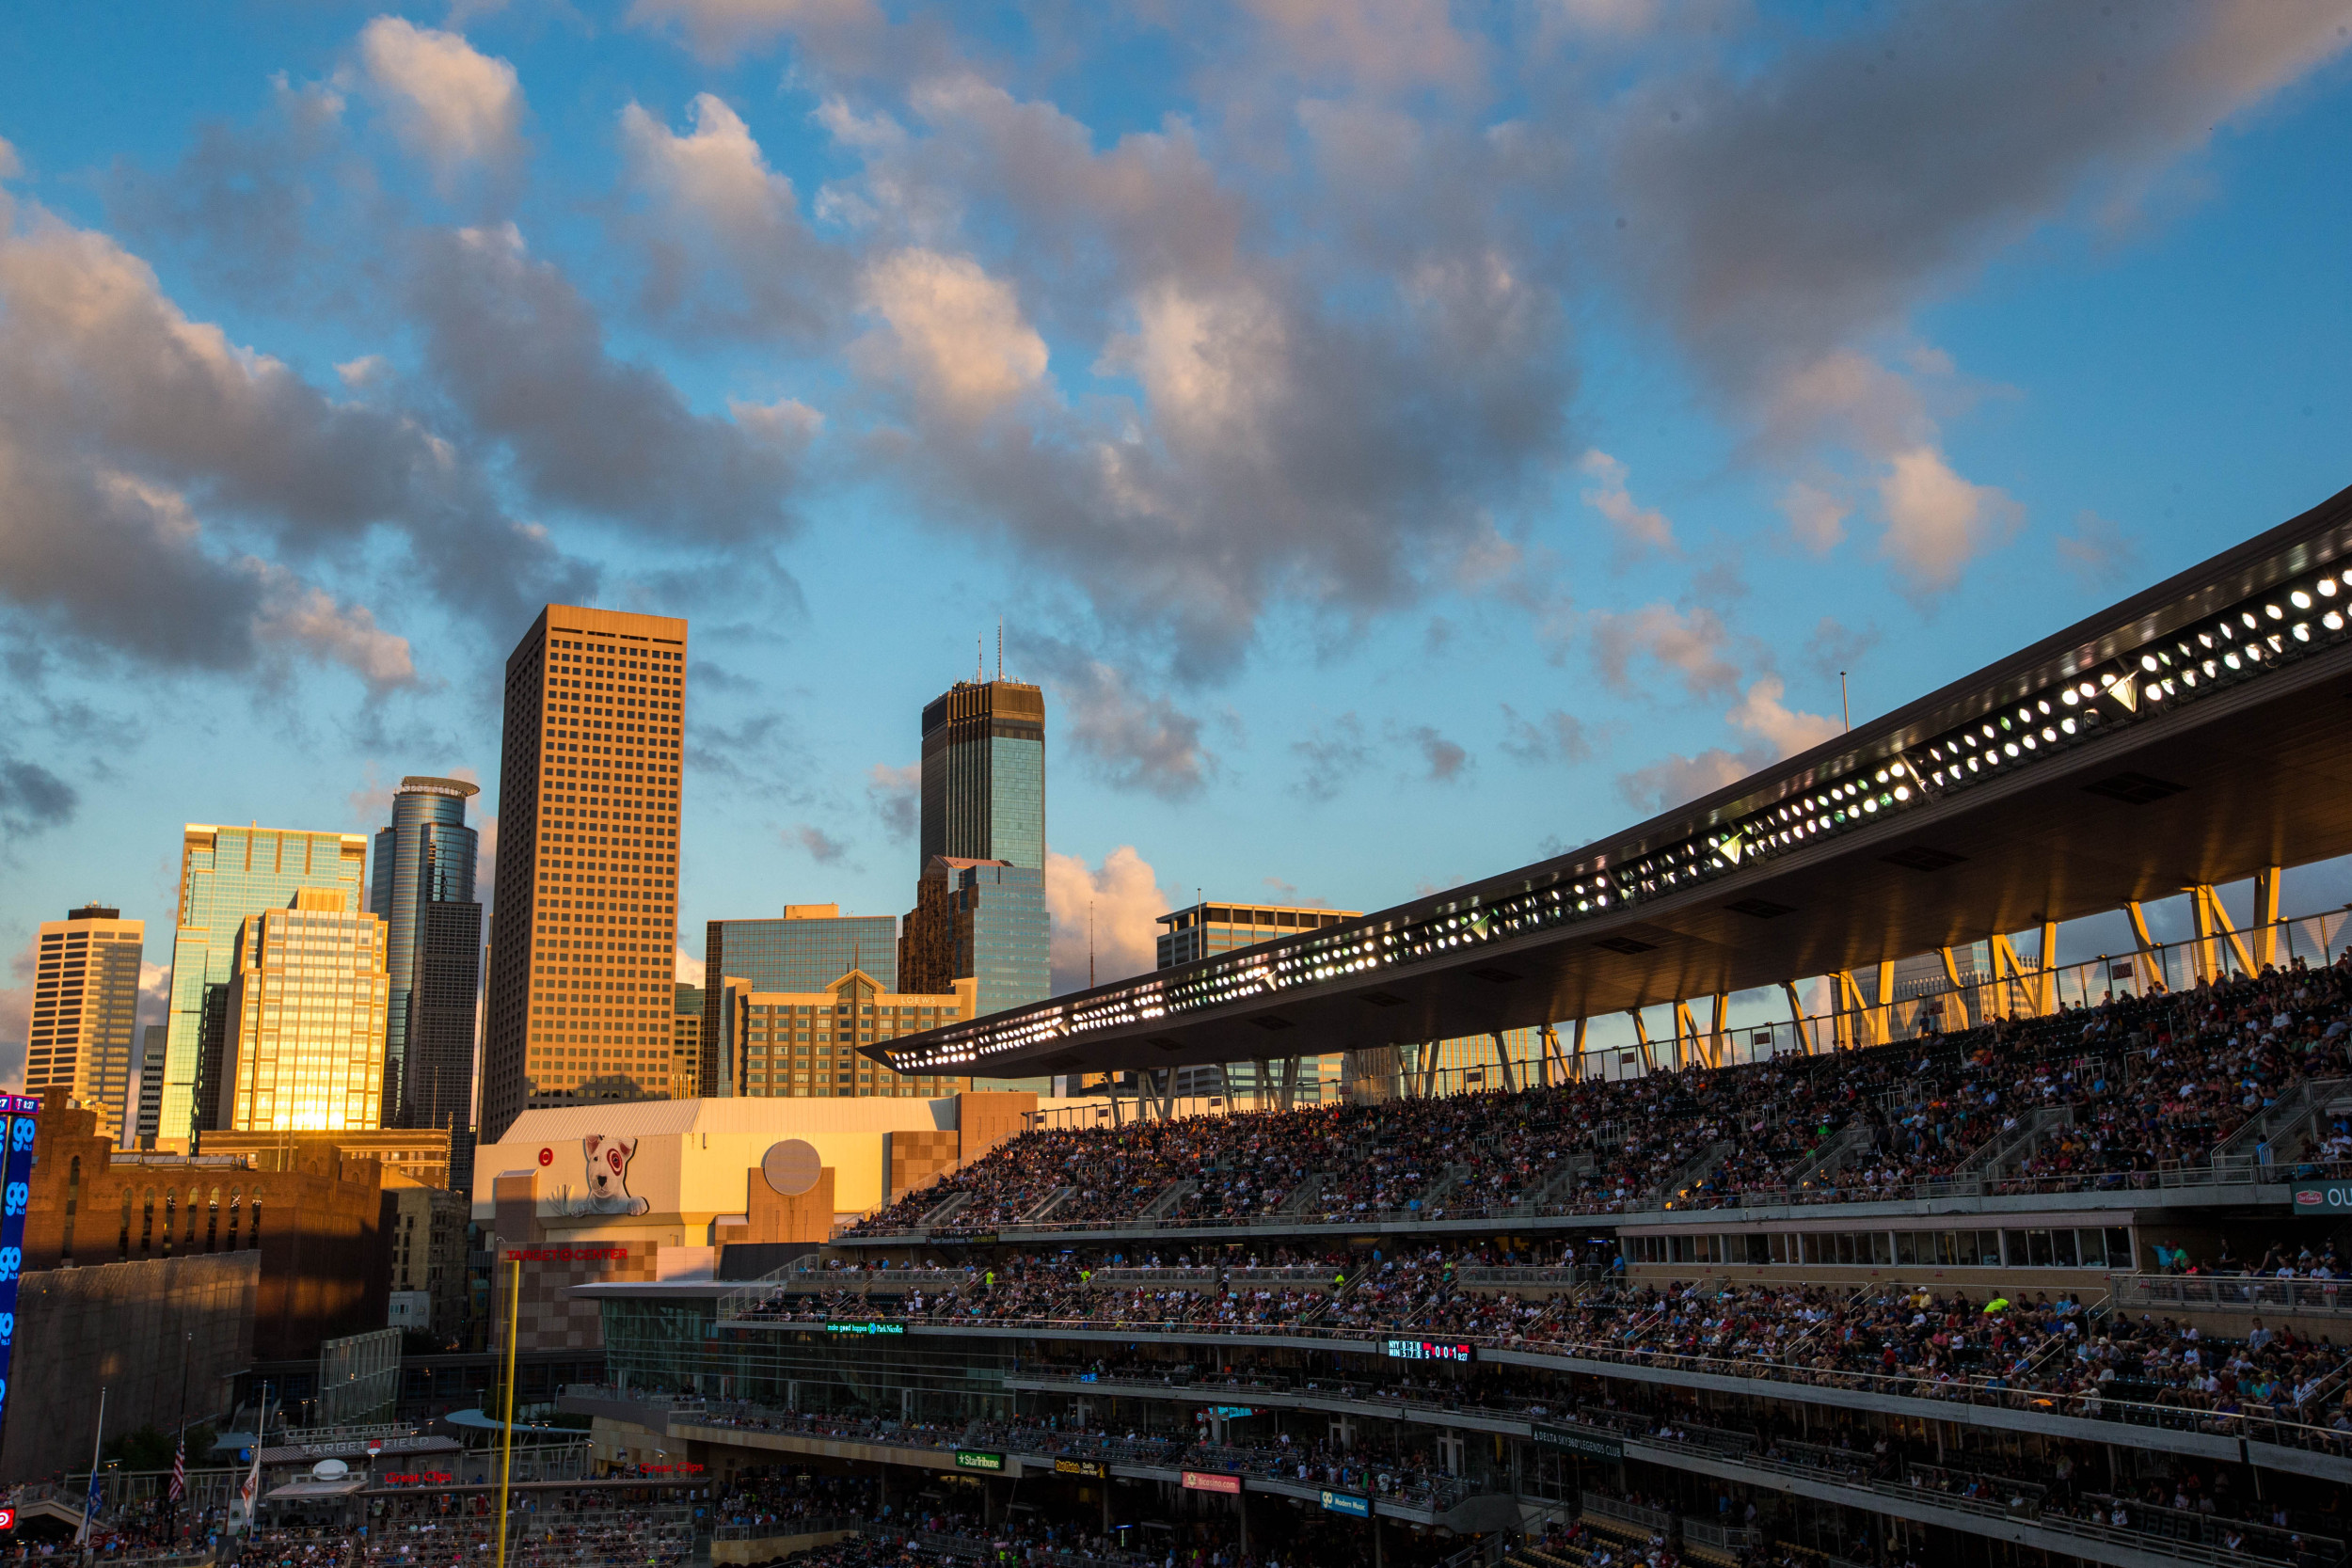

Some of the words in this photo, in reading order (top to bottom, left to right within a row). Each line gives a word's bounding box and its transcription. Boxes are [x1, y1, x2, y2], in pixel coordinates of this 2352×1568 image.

[12, 1118, 36, 1152] go
[5, 1181, 28, 1216] go
[507, 1250, 559, 1261] TARGET
[575, 1248, 628, 1260] CENTER
[0, 1247, 22, 1282] go
[839, 1323, 851, 1333] good
[851, 1324, 867, 1334] happen
[886, 1324, 903, 1334] Nicollet
[1389, 1339, 1400, 1349] NYY
[1389, 1349, 1400, 1357] MIN
[1425, 1350, 1430, 1359] 5
[1435, 1345, 1440, 1358] 0
[1443, 1346, 1449, 1358] 0
[1452, 1346, 1457, 1359] 1
[1457, 1353, 1468, 1361] 8:27
[302, 1441, 367, 1455] TARGET
[384, 1437, 429, 1449] FIELD
[1538, 1431, 1558, 1443] DELTA
[1580, 1441, 1604, 1454] LEGENDS
[1605, 1445, 1621, 1458] CLUB
[640, 1463, 674, 1474] Great
[676, 1461, 705, 1475] Clips
[964, 1453, 999, 1469] StarTribune
[1055, 1459, 1066, 1472] Old
[1065, 1461, 1080, 1474] Dutch
[385, 1472, 420, 1483] Great
[423, 1470, 453, 1483] Clips
[1198, 1476, 1236, 1490] ticasino.com
[1322, 1491, 1333, 1509] go
[1334, 1497, 1352, 1509] Modern
[1352, 1500, 1366, 1512] Music
